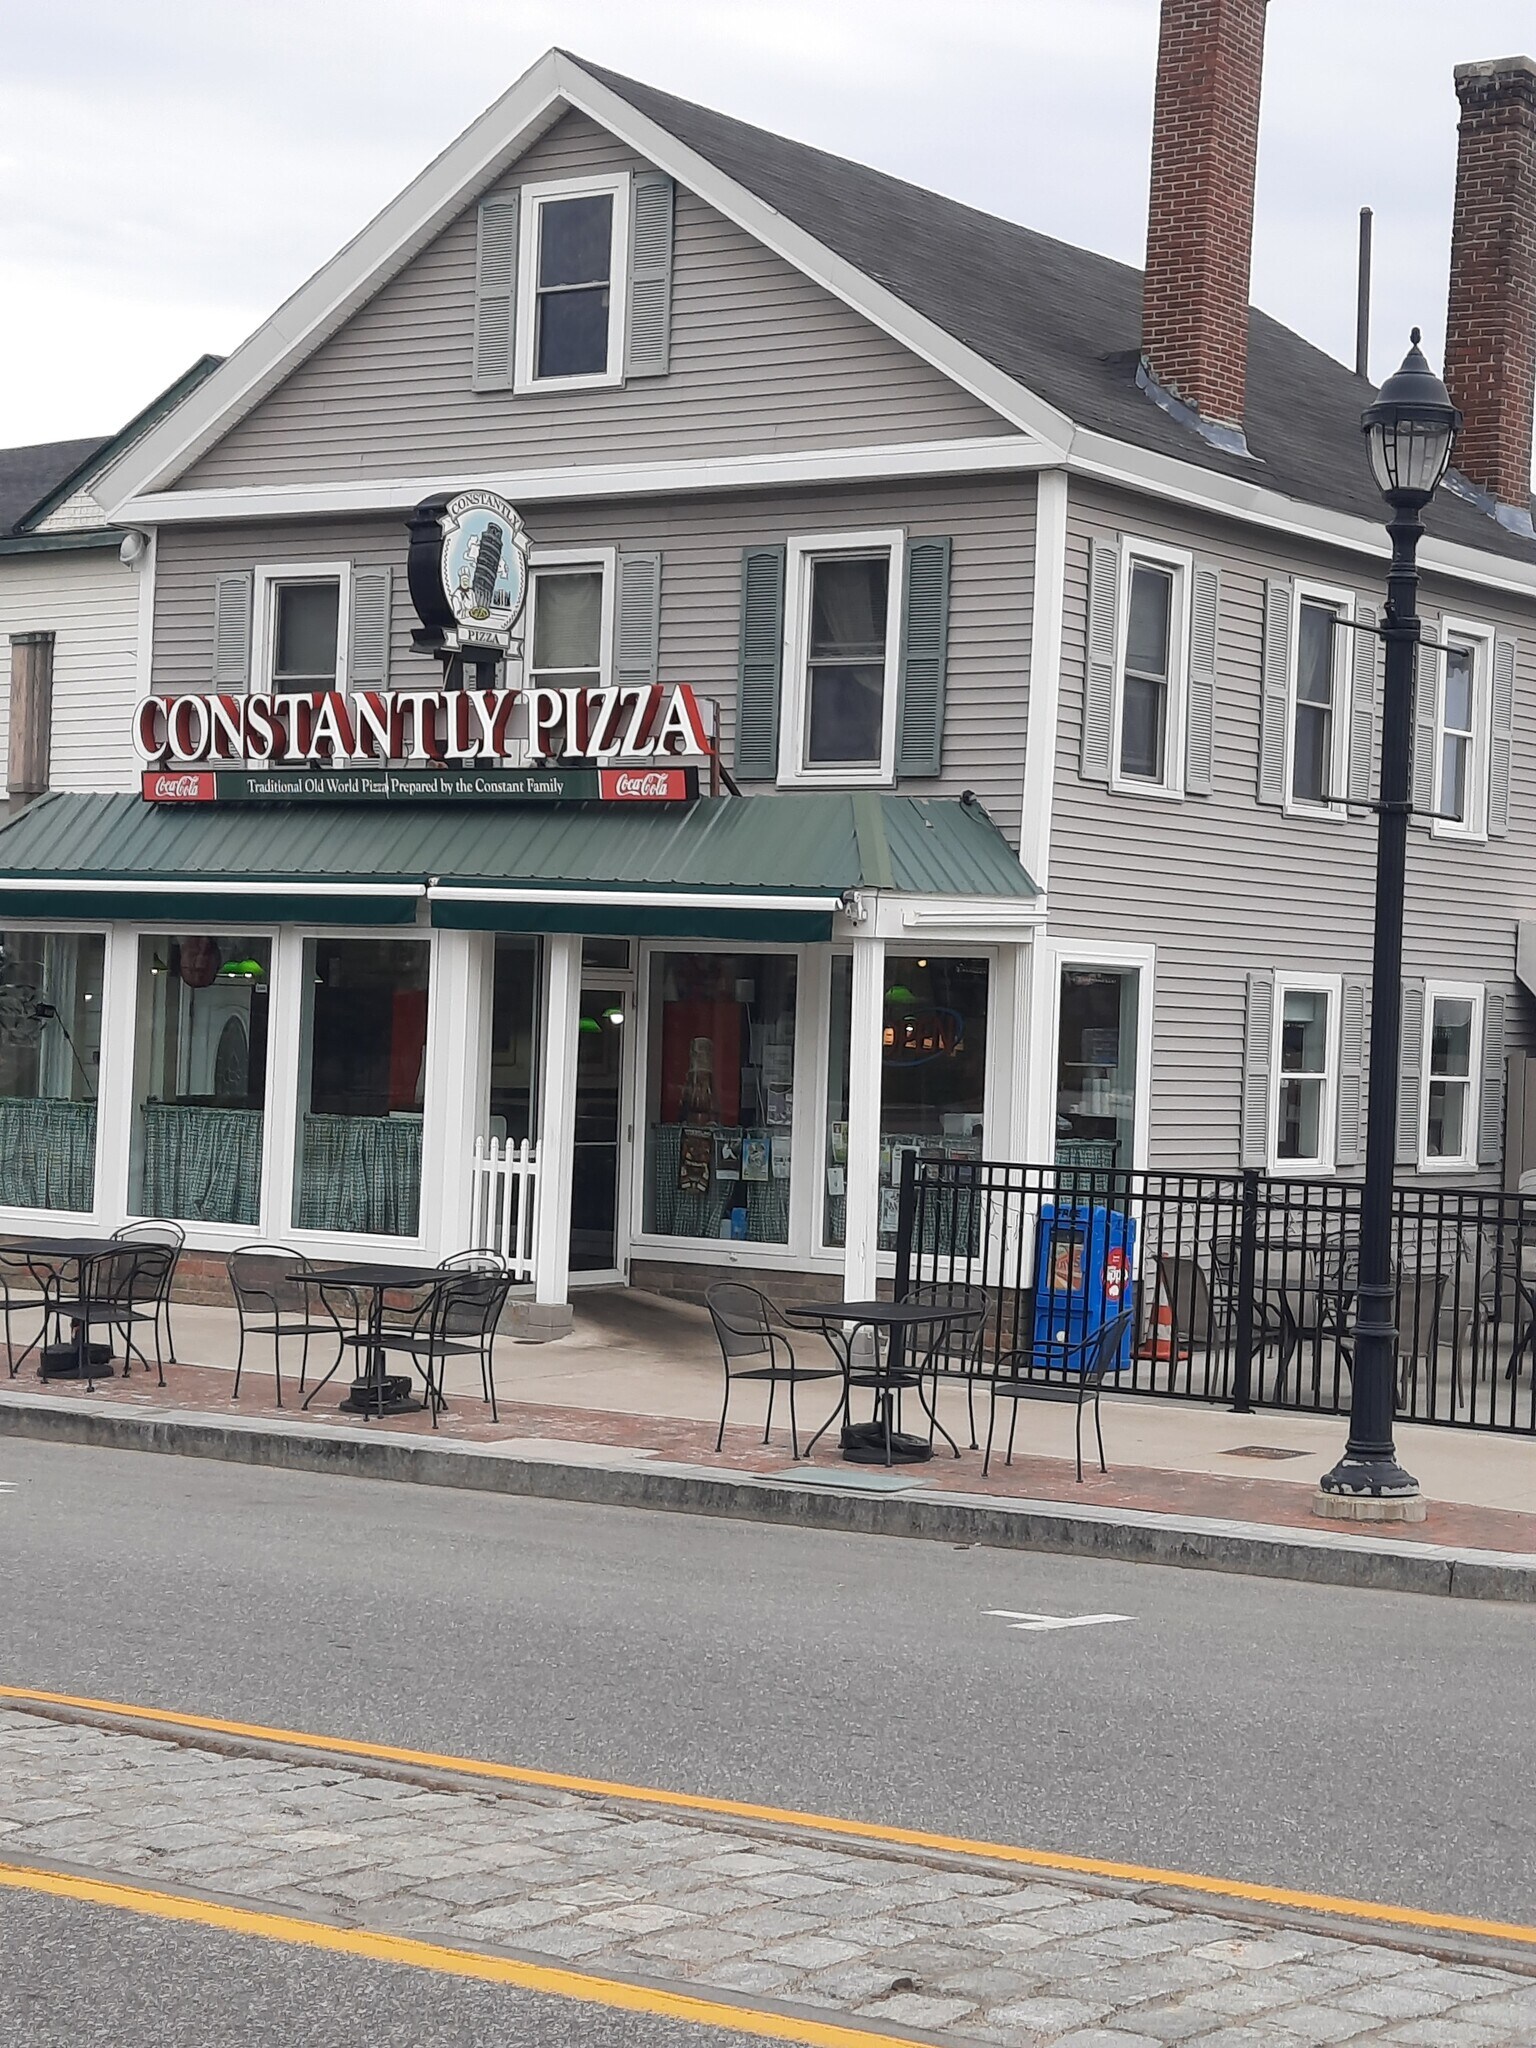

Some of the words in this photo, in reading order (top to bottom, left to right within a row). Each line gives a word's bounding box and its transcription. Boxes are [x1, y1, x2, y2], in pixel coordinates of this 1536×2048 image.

[451, 493, 520, 528] CONSTANTLY
[468, 631, 500, 643] PIZZA
[132, 688, 511, 761] CONSTANTLY
[523, 684, 705, 759] PIZZA
[247, 778, 302, 793] Traditional
[305, 778, 325, 793] Old
[327, 777, 360, 793] World
[391, 777, 438, 794] Prepared
[440, 777, 453, 794] by
[456, 777, 473, 793] the
[475, 777, 523, 793] Constant
[526, 777, 564, 795] Family
